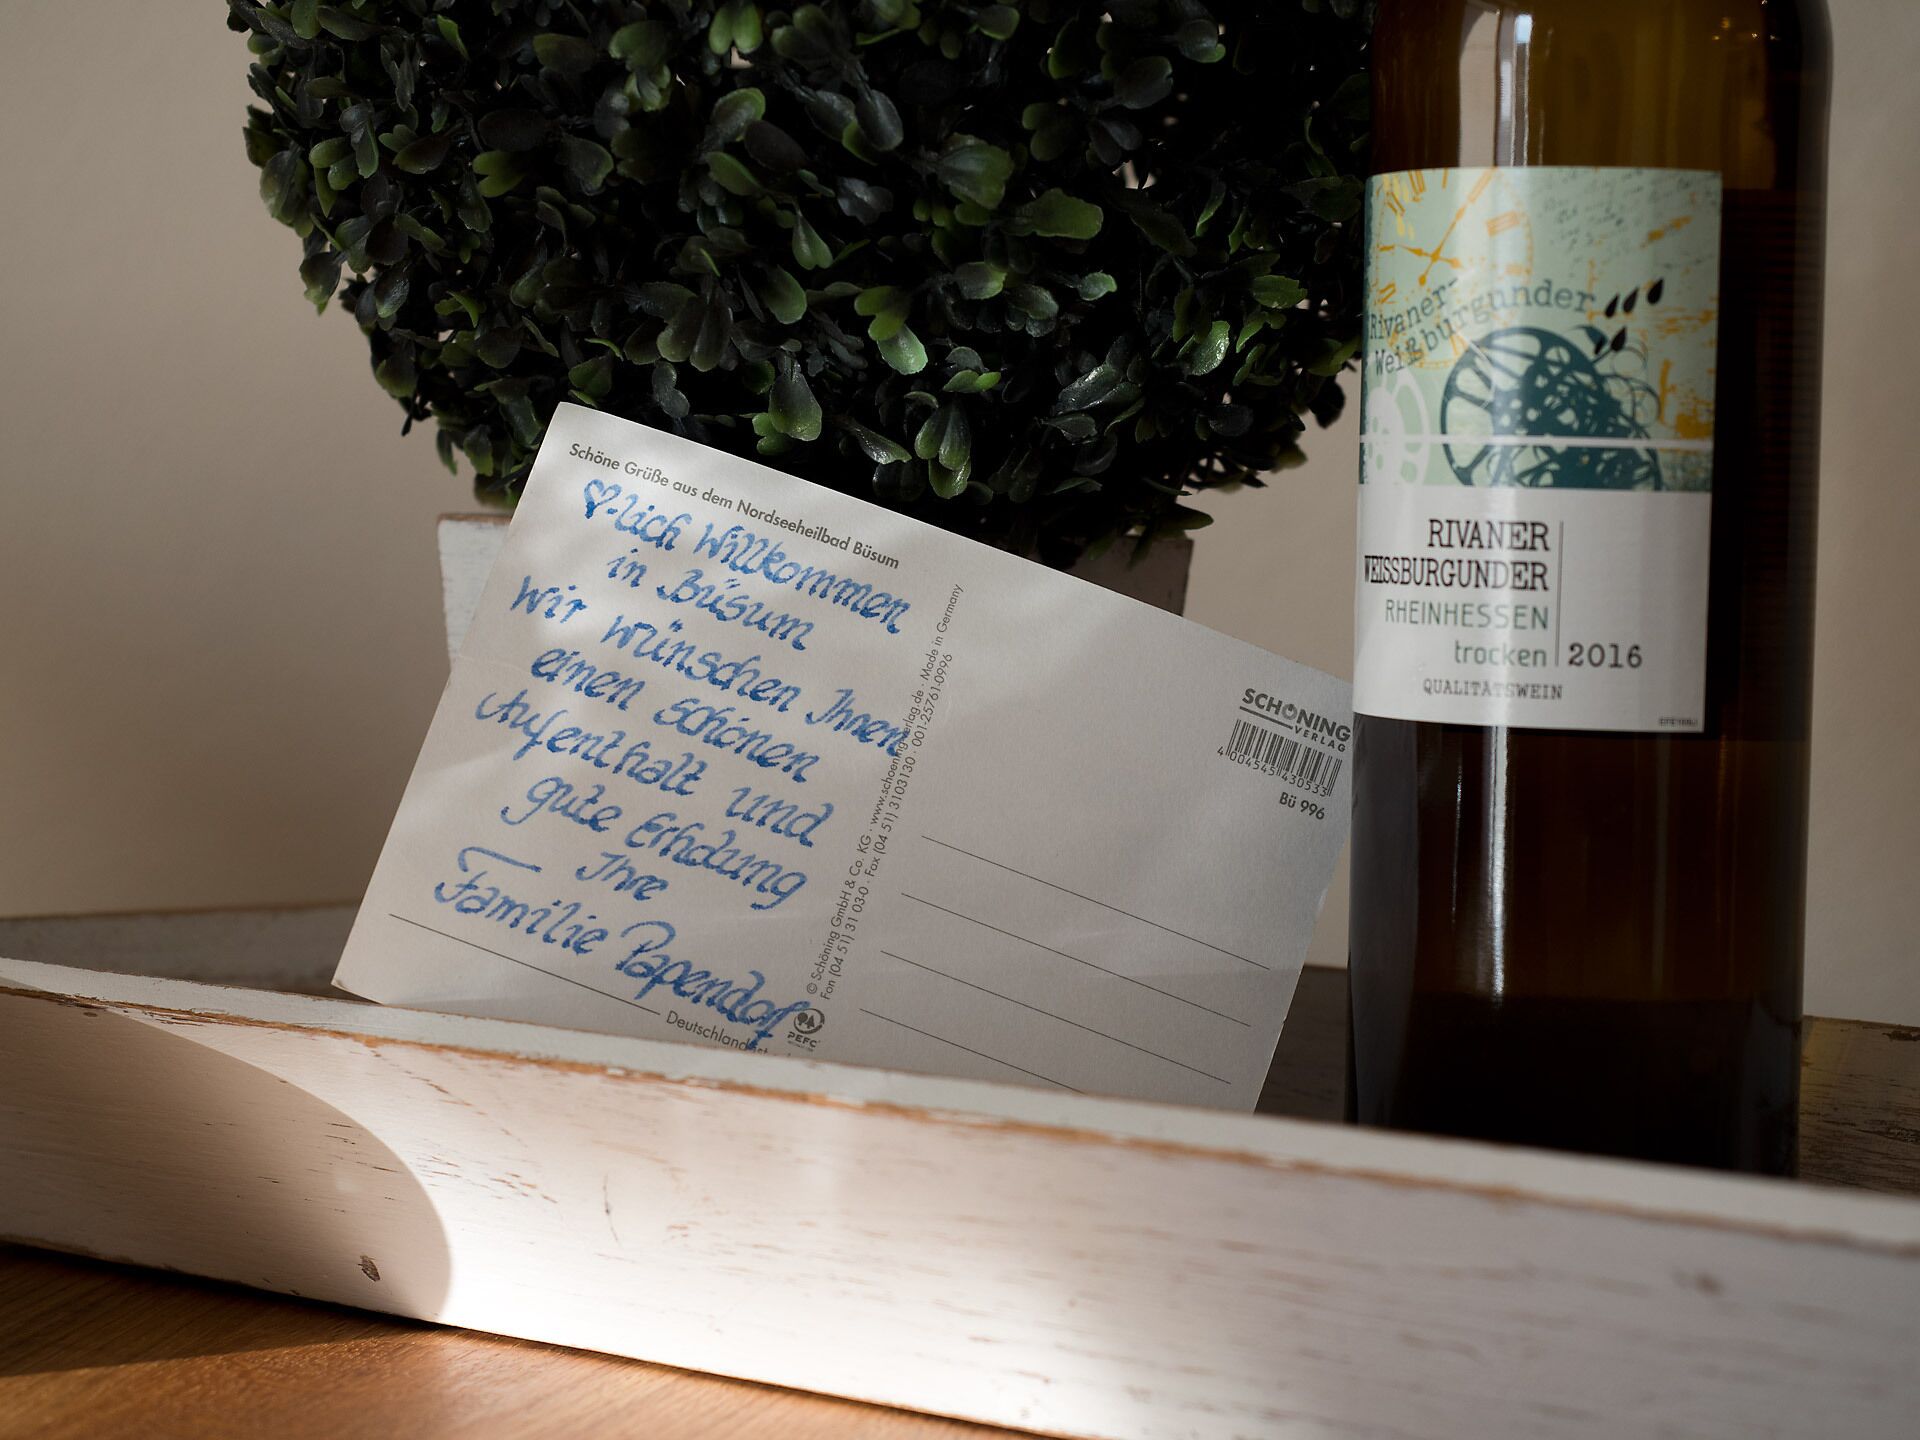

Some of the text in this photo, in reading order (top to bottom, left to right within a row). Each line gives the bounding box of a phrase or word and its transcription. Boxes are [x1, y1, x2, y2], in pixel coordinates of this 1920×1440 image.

[569, 443, 900, 570] Schöne Grüße aus dem Nordseeheilbad Büsum
[1427, 518, 1551, 551] RIVANER
[607, 548, 814, 651] in Büsum
[693, 522, 911, 634] Willkommen
[936, 584, 964, 633] Germany
[1385, 599, 1549, 630] RHEINHESSEN
[932, 636, 944, 647] in
[1454, 640, 1643, 669] trocken 2016
[531, 648, 646, 711] einen
[920, 649, 939, 681] Made
[805, 688, 910, 757] Ihnen
[1295, 725, 1346, 752] VERLAG
[475, 689, 834, 848] Aufenthalt und
[820, 654, 953, 1000] Fon (04 51) 31 03-0 Fax (04 51) 3103130 001-25761-0996
[1279, 791, 1325, 821] Bü 996
[500, 776, 808, 910] gute Erholung
[857, 835, 871, 854] KG
[575, 852, 669, 901] Ihre
[844, 880, 857, 889] &
[849, 859, 865, 876] Co.
[434, 846, 609, 955] Familie
[830, 890, 852, 927] GmbH
[811, 931, 840, 981] Schöning
[787, 1031, 817, 1048] PEFC
